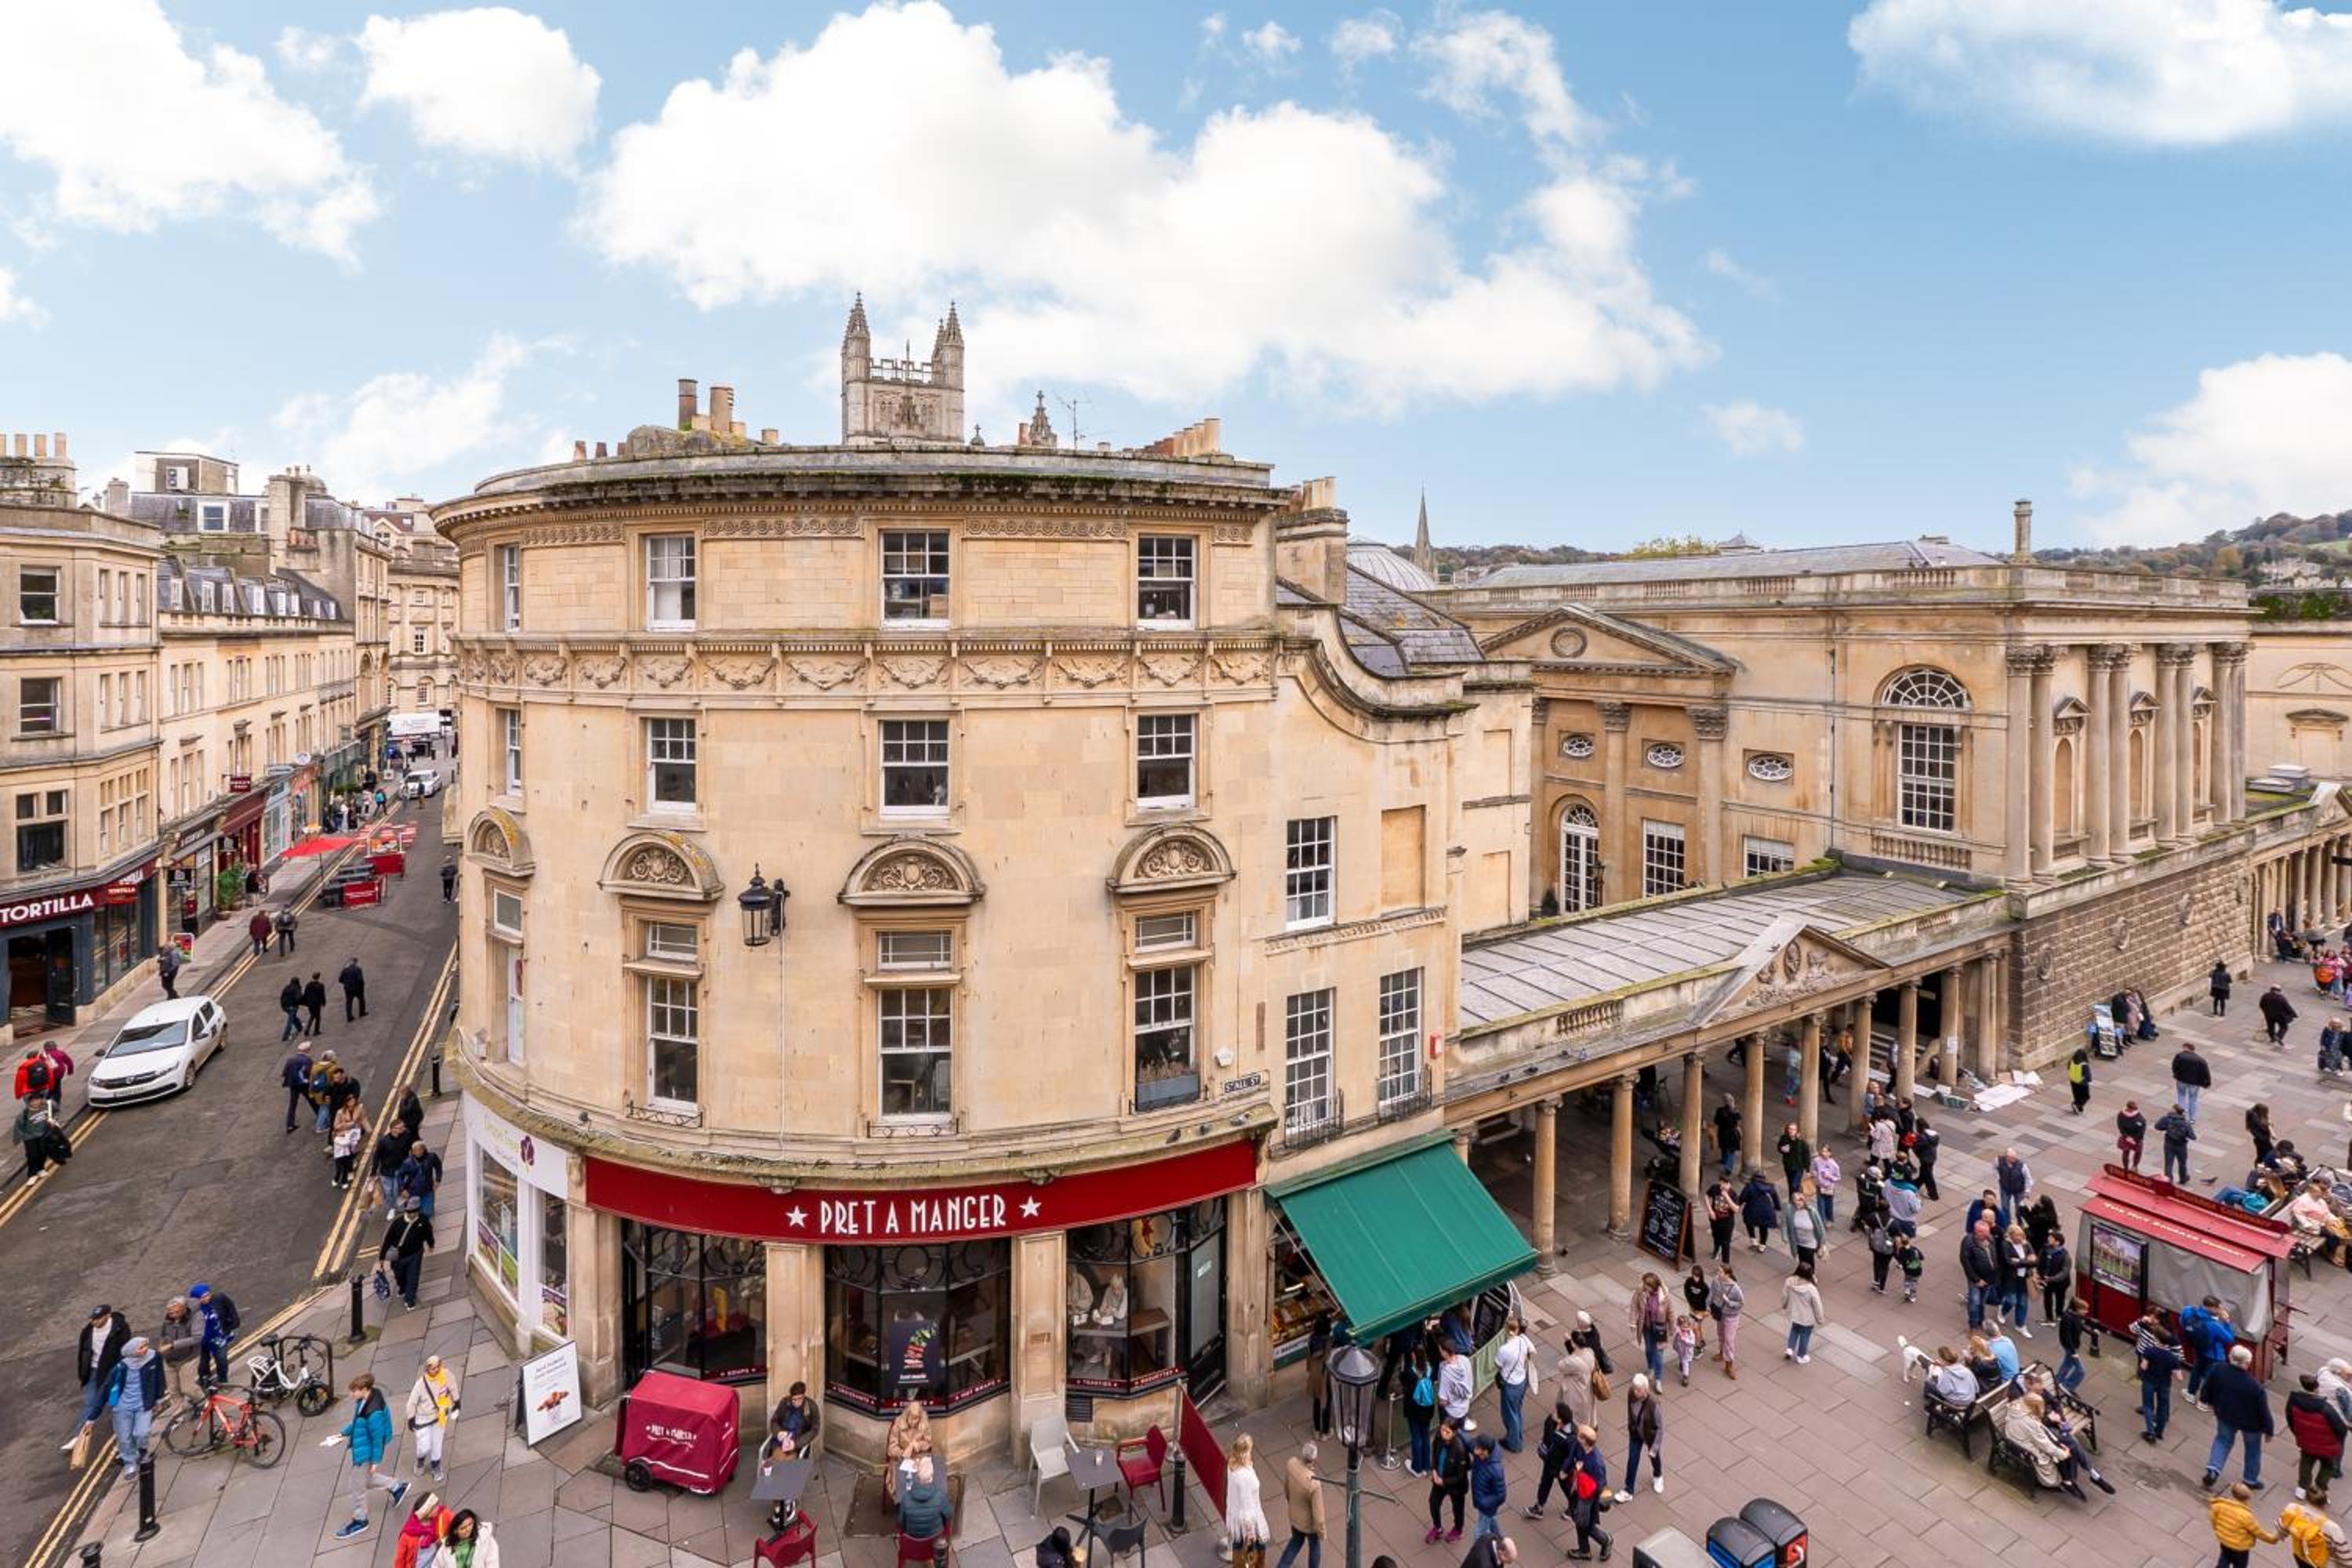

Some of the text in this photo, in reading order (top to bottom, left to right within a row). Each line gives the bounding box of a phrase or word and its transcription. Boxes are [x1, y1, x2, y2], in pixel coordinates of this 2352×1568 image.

[0, 893, 94, 923] TORTILLA
[821, 1194, 1007, 1235] PRET A MANGER
